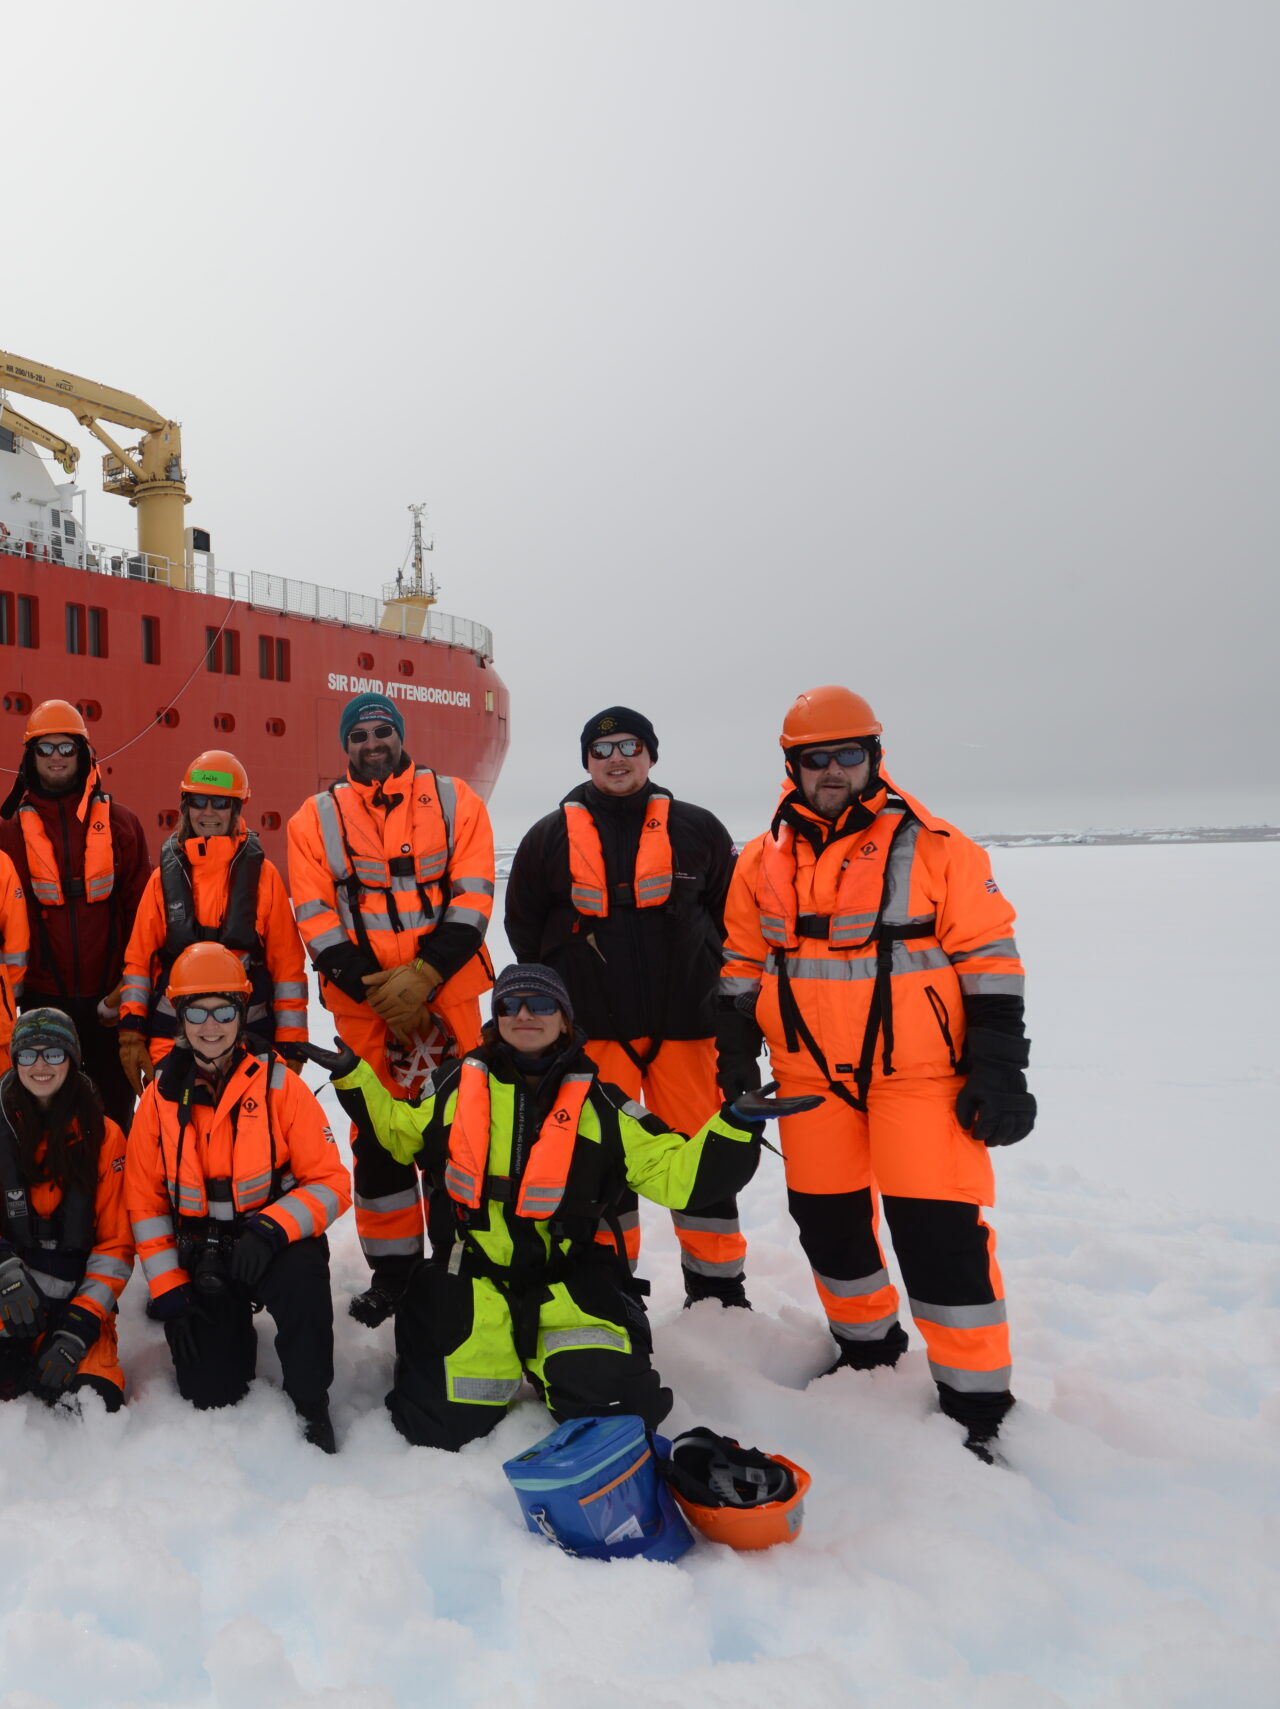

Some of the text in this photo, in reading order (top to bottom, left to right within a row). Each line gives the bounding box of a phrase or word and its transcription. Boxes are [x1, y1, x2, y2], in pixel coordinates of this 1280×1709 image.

[328, 672, 471, 708] SIR DAVID ATTENBOROUGH
